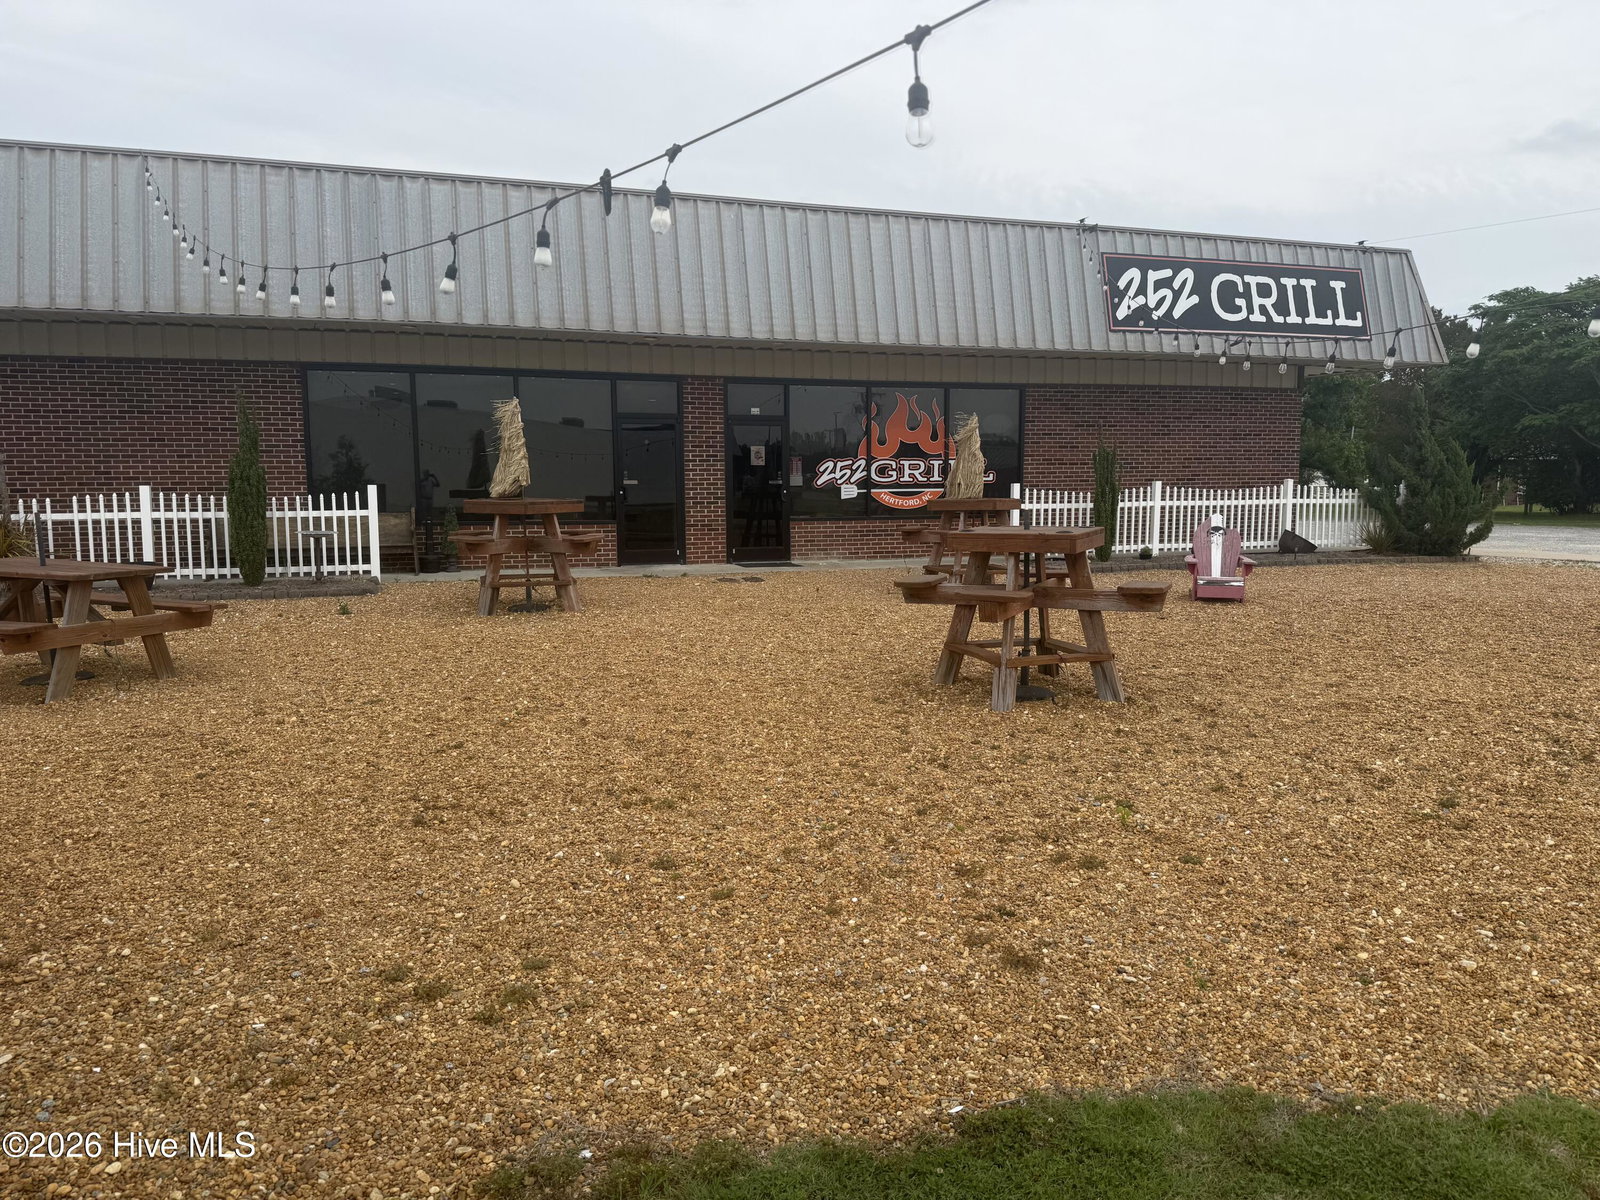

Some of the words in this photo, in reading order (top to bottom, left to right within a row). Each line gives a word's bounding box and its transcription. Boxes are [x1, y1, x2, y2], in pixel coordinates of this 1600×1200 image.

[1115, 267, 1200, 321] 252
[1210, 272, 1363, 327] GRILL
[815, 457, 868, 487] 252
[870, 459, 994, 482] GRI
[922, 491, 934, 502] NC
